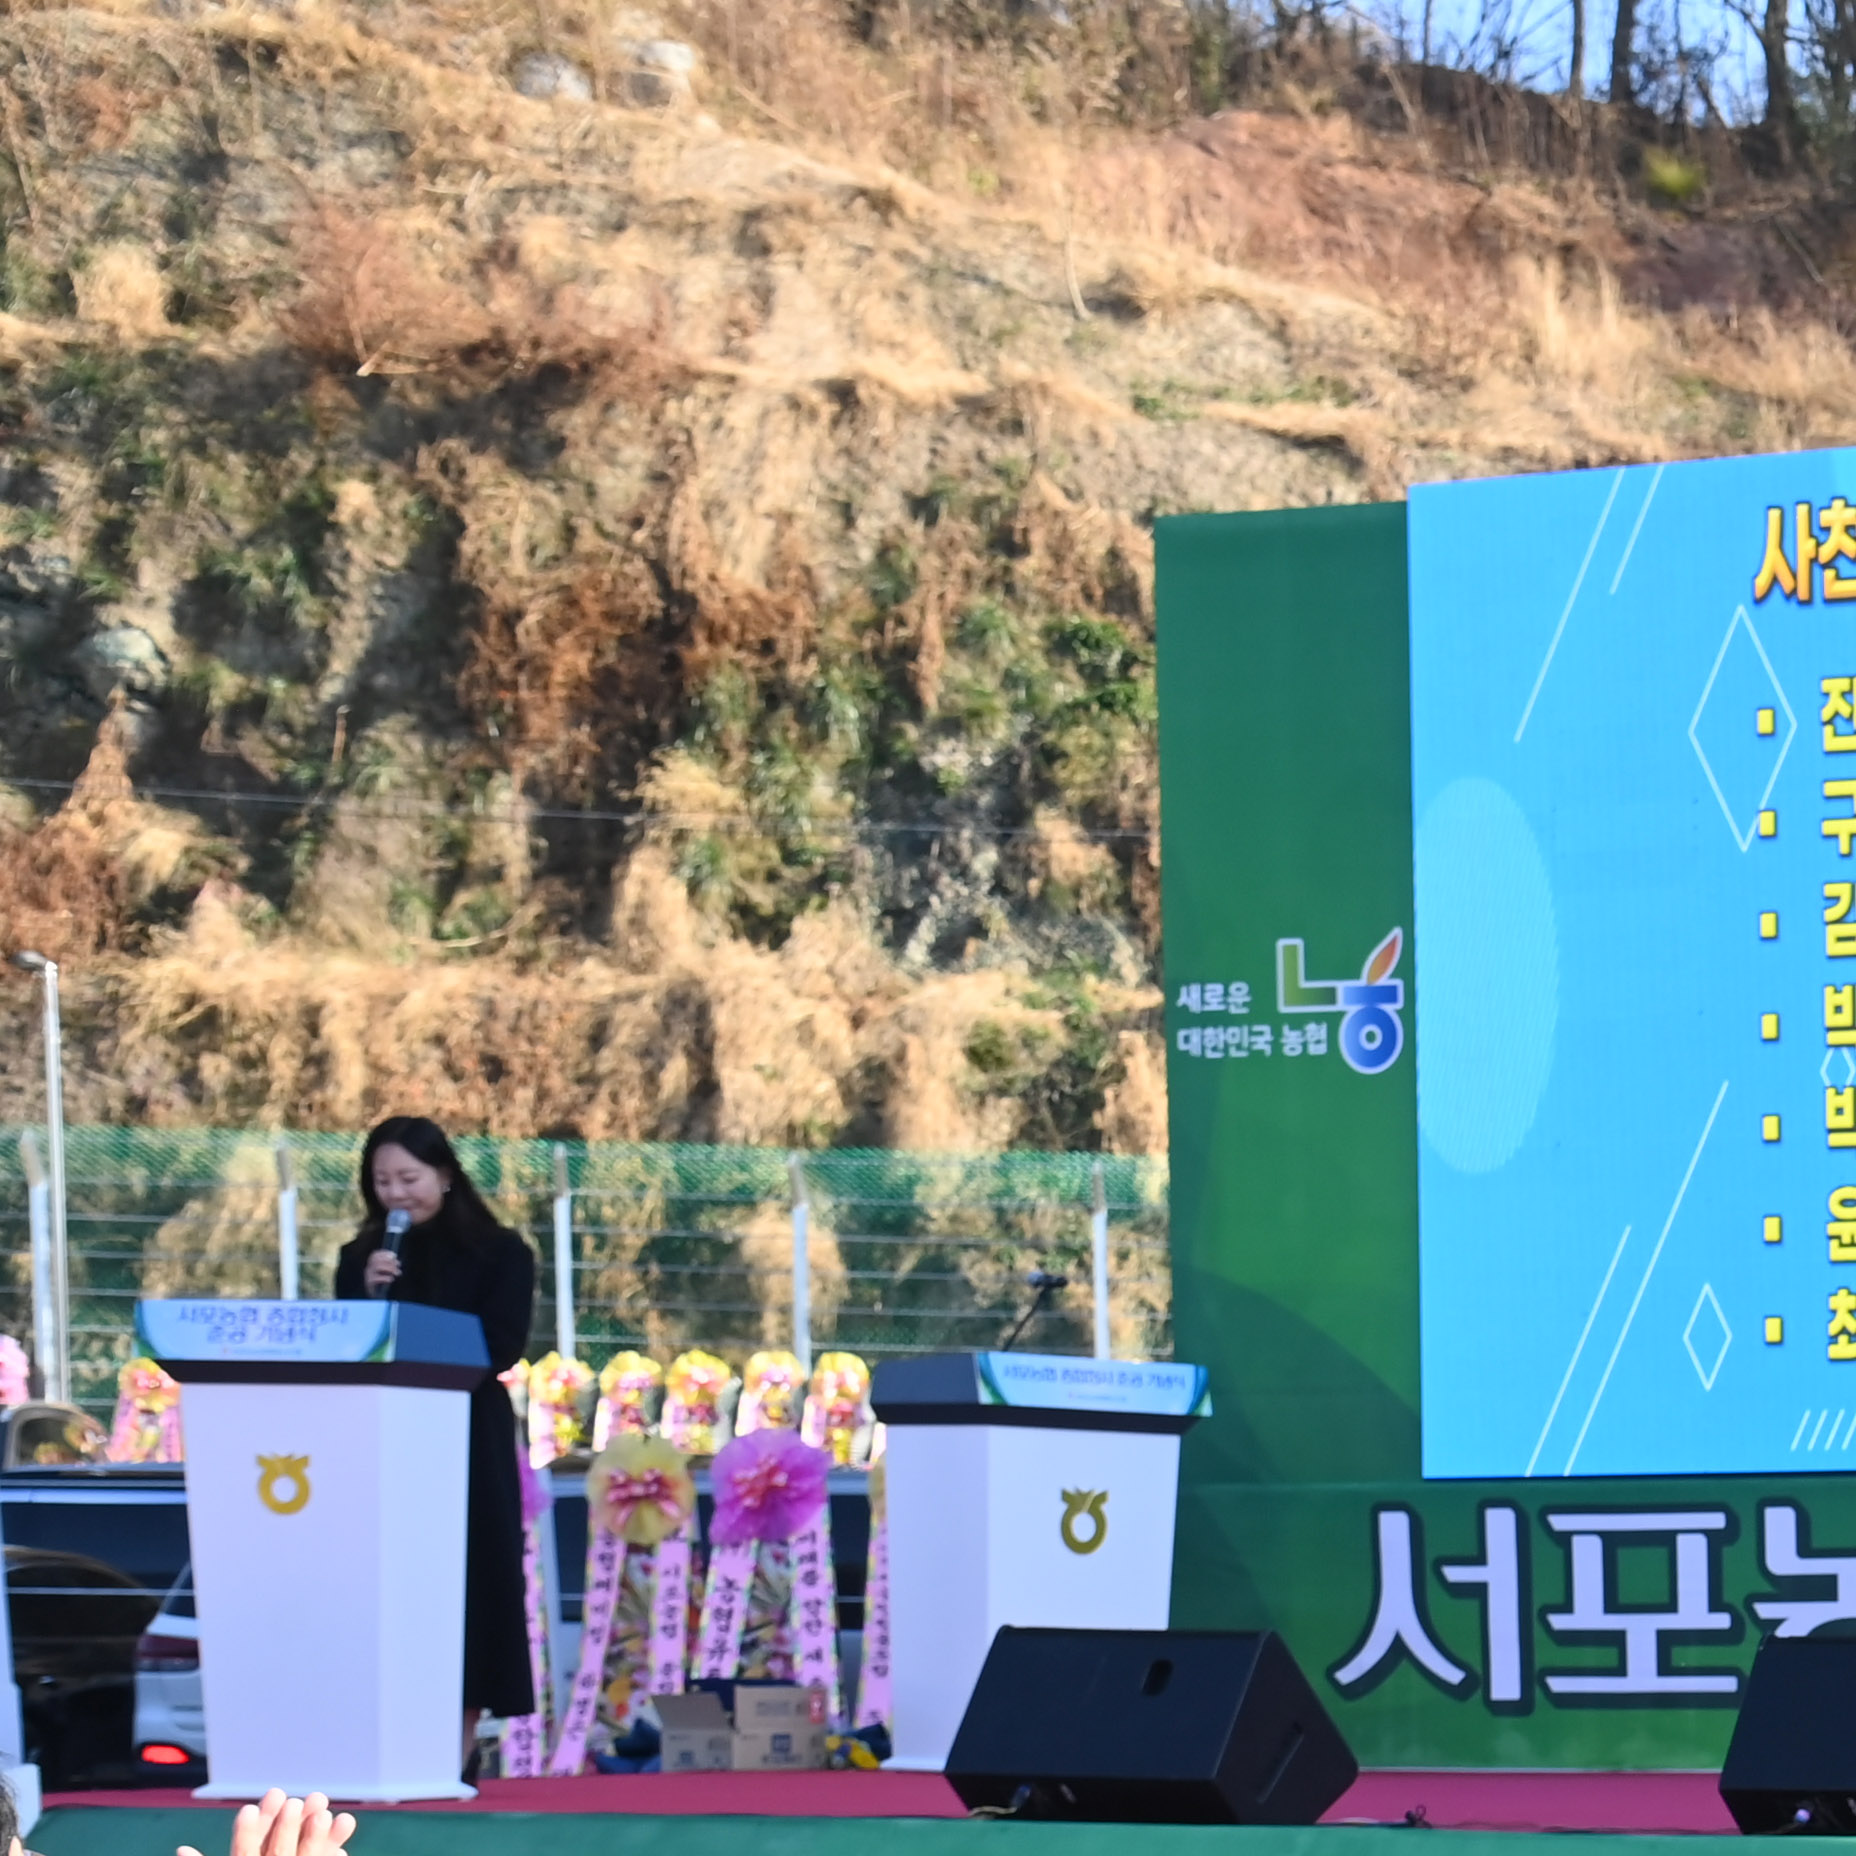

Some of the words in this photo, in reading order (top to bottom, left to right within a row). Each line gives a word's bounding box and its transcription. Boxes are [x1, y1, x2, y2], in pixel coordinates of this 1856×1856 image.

[1176, 981, 1252, 1014] 새로운
[1176, 1024, 1274, 1059] 대한민국
[1280, 1020, 1329, 1057] 농협
